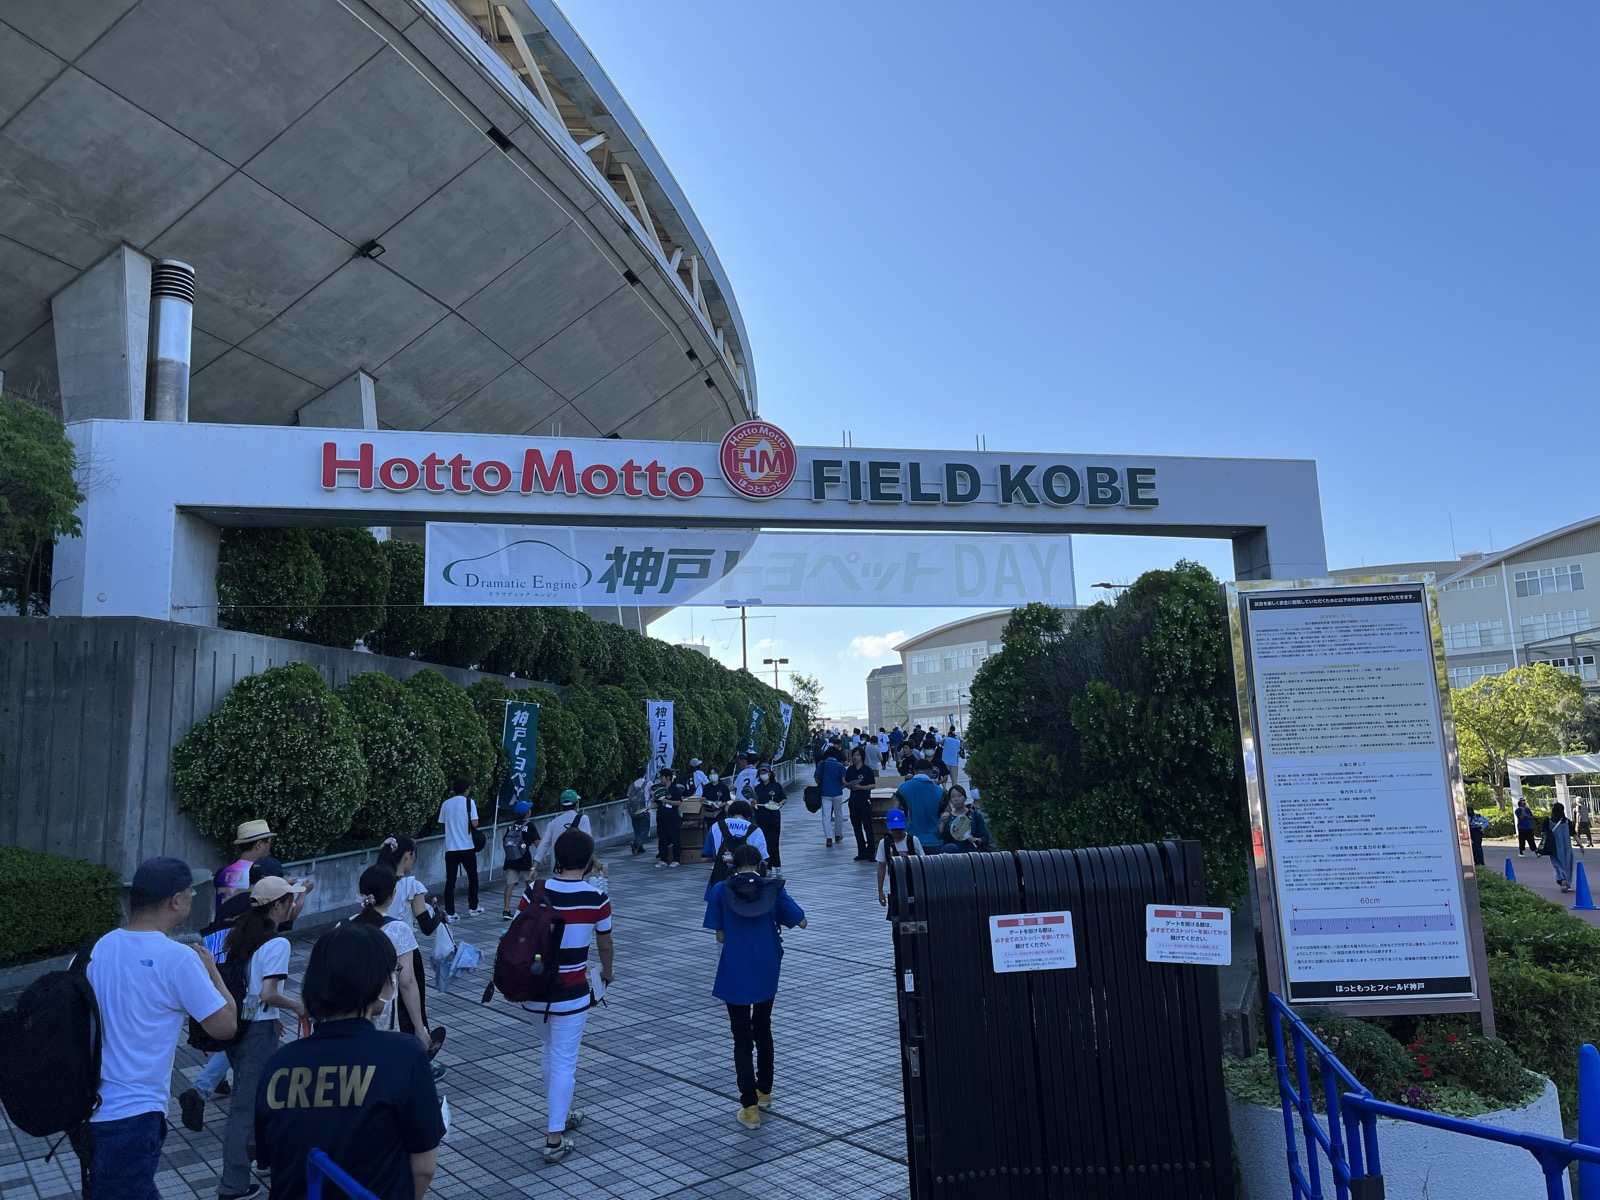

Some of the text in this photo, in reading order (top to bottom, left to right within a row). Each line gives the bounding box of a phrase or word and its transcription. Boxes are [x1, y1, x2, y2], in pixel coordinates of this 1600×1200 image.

[729, 426, 787, 449] Hotto Motto
[321, 441, 704, 499] Hotto Motto
[732, 448, 787, 474] HM
[738, 478, 784, 493] ほっともっと
[811, 459, 1160, 508] FIELD KOBE
[465, 573, 578, 591] Dramatic Engine
[1335, 982, 1425, 993] ほっともっとフィールド神戸
[266, 1065, 377, 1110] CREW
